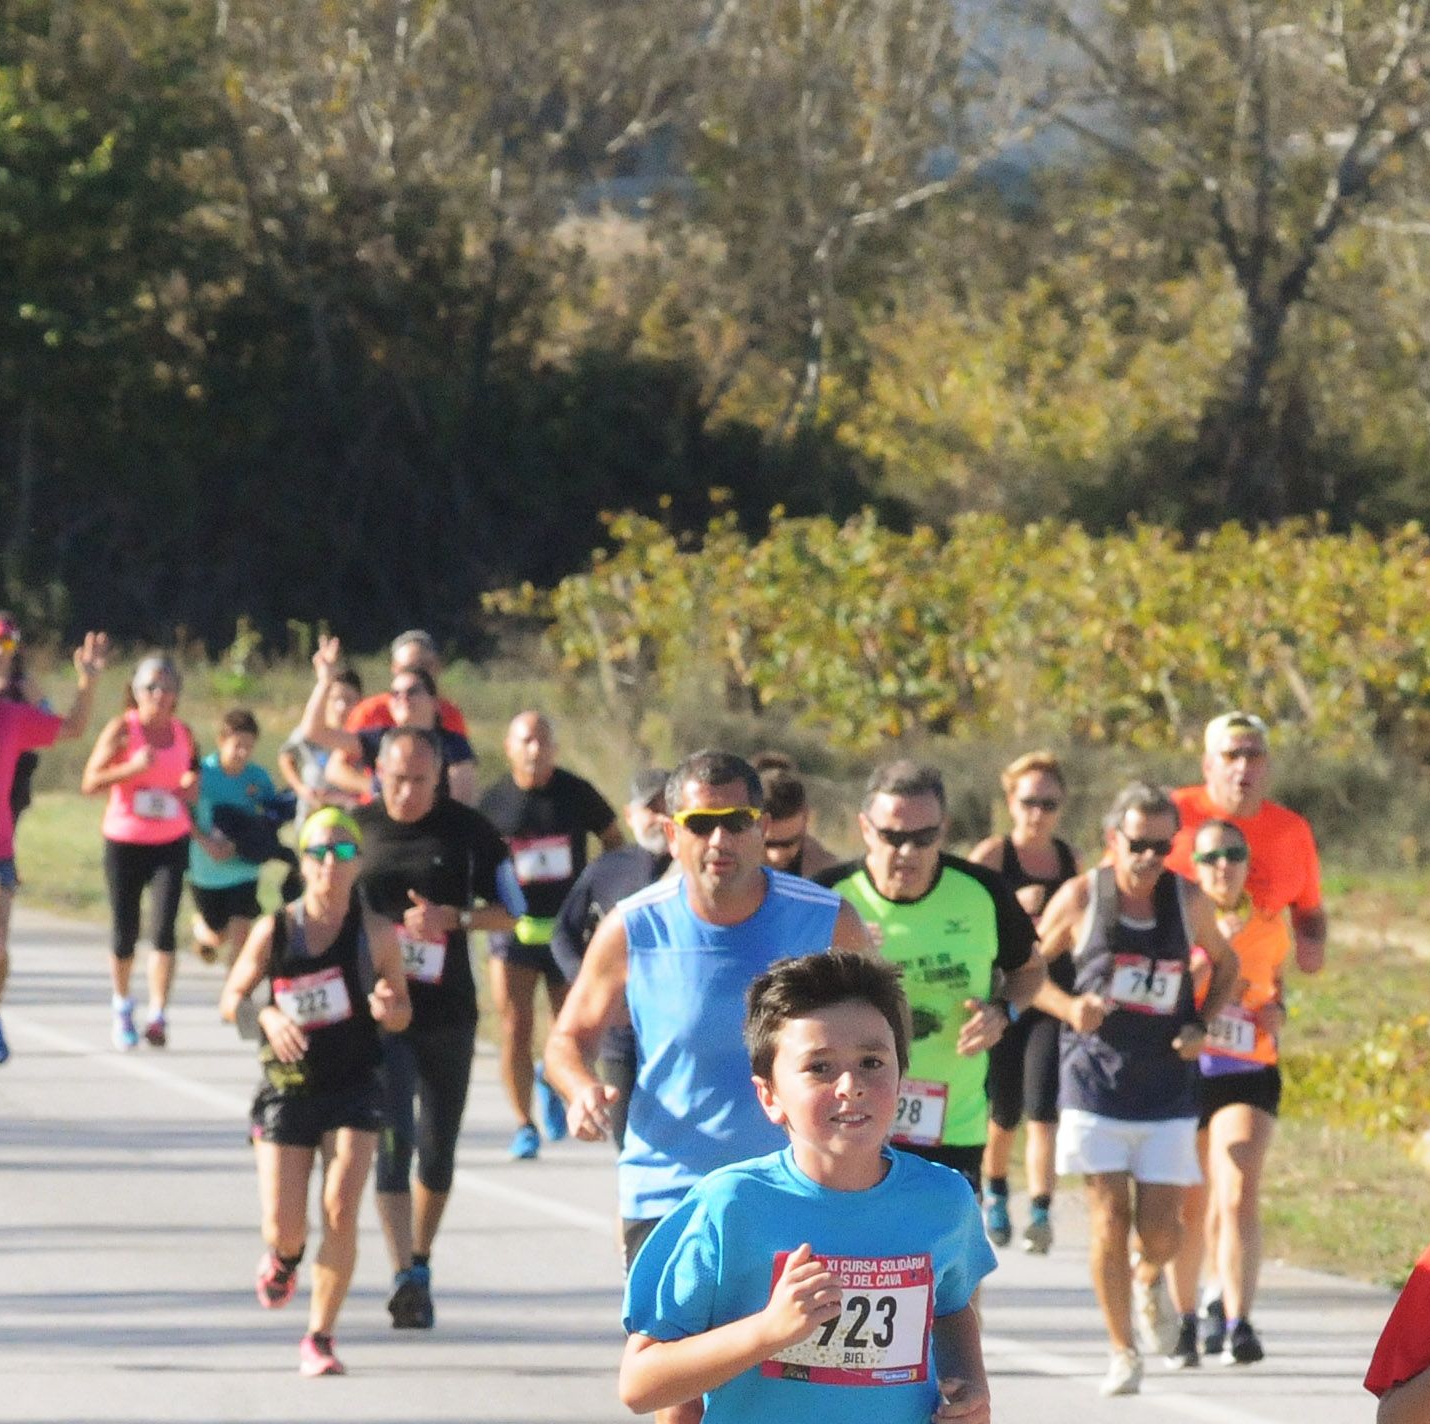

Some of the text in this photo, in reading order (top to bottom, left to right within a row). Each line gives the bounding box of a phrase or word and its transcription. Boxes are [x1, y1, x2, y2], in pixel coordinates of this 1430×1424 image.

[826, 1260, 838, 1271] XI
[840, 1260, 877, 1272] CURSA
[852, 1275, 874, 1286] DEL
[876, 1274, 902, 1286] CAVA
